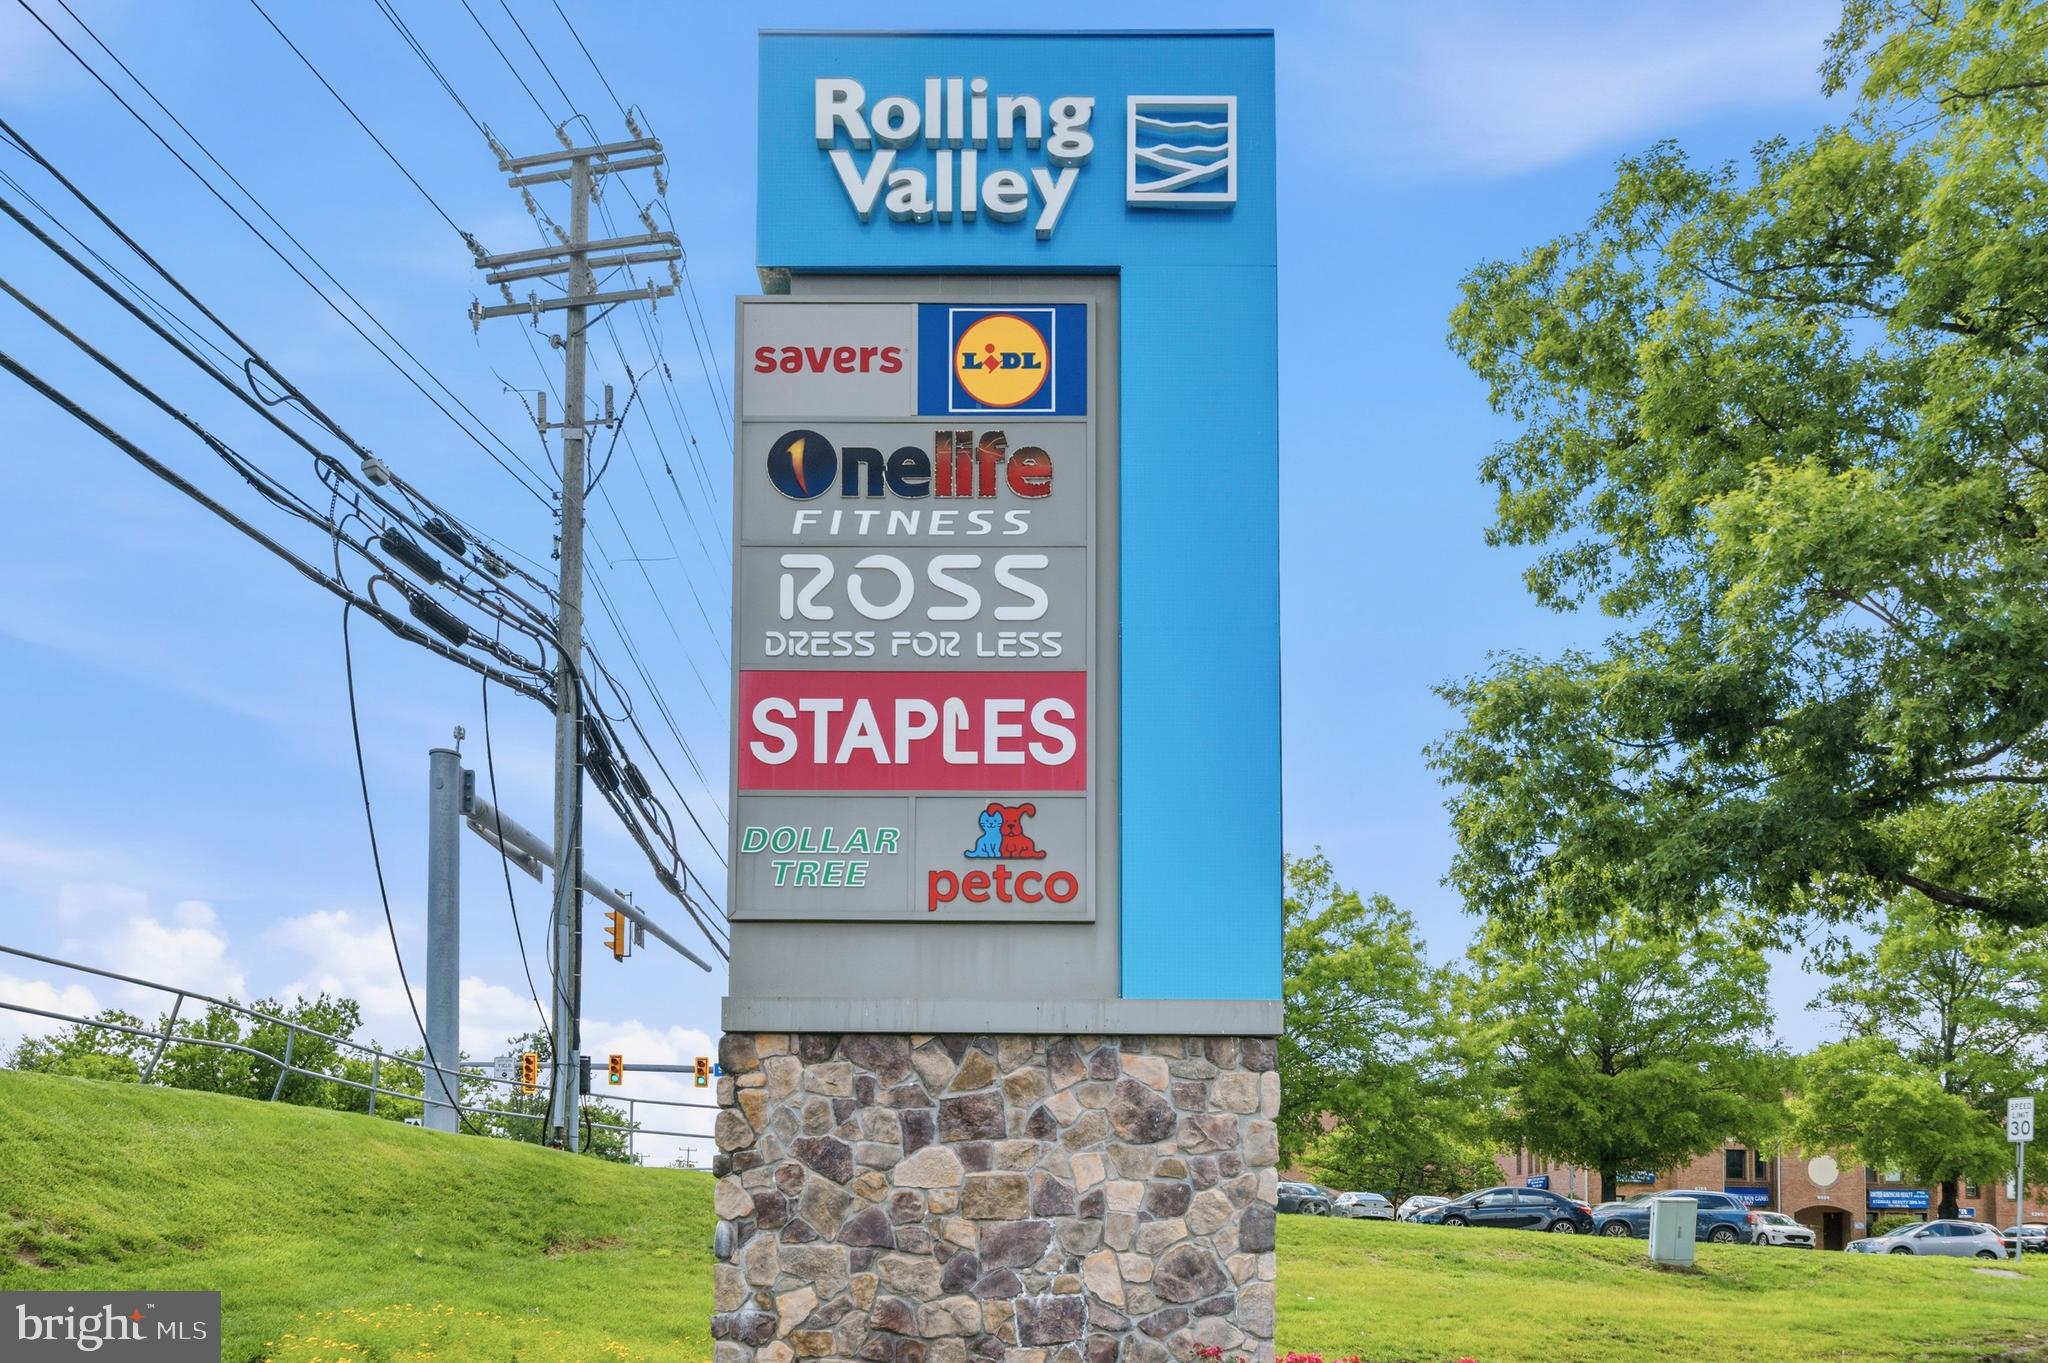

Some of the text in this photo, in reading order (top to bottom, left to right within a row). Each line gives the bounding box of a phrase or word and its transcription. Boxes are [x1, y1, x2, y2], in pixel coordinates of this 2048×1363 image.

[814, 76, 1096, 168] Rolling
[827, 149, 1081, 241] Valley
[753, 345, 904, 375] savers
[791, 509, 1032, 536] FITNESS
[779, 553, 1050, 621] ROSS
[764, 630, 1064, 658] DRESS FOR LESS
[749, 696, 1077, 767] STAPLES
[740, 826, 901, 855] DOLLAR
[770, 860, 870, 888] TREE
[928, 864, 1079, 913] petco
[2010, 1102, 2032, 1111] SPEED
[2012, 1111, 2030, 1119] LIMIT
[2010, 1120, 2031, 1136] 30
